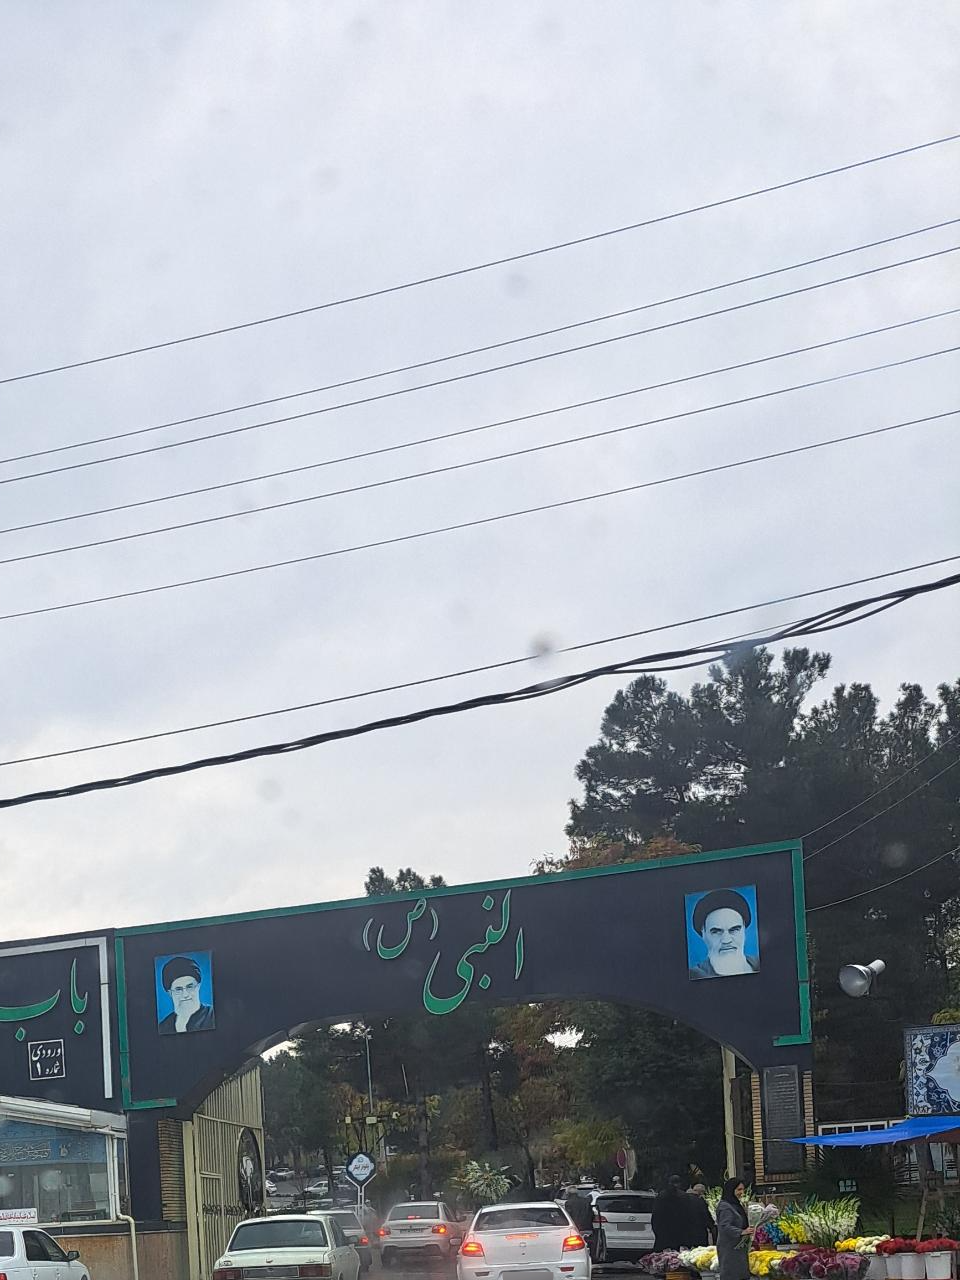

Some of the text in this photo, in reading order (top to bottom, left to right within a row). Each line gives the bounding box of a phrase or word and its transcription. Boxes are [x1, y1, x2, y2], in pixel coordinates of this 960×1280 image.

[361, 888, 525, 1015] النبی (ص)
[31, 1044, 61, 1061] ورودی
[45, 1060, 61, 1075] شماره
